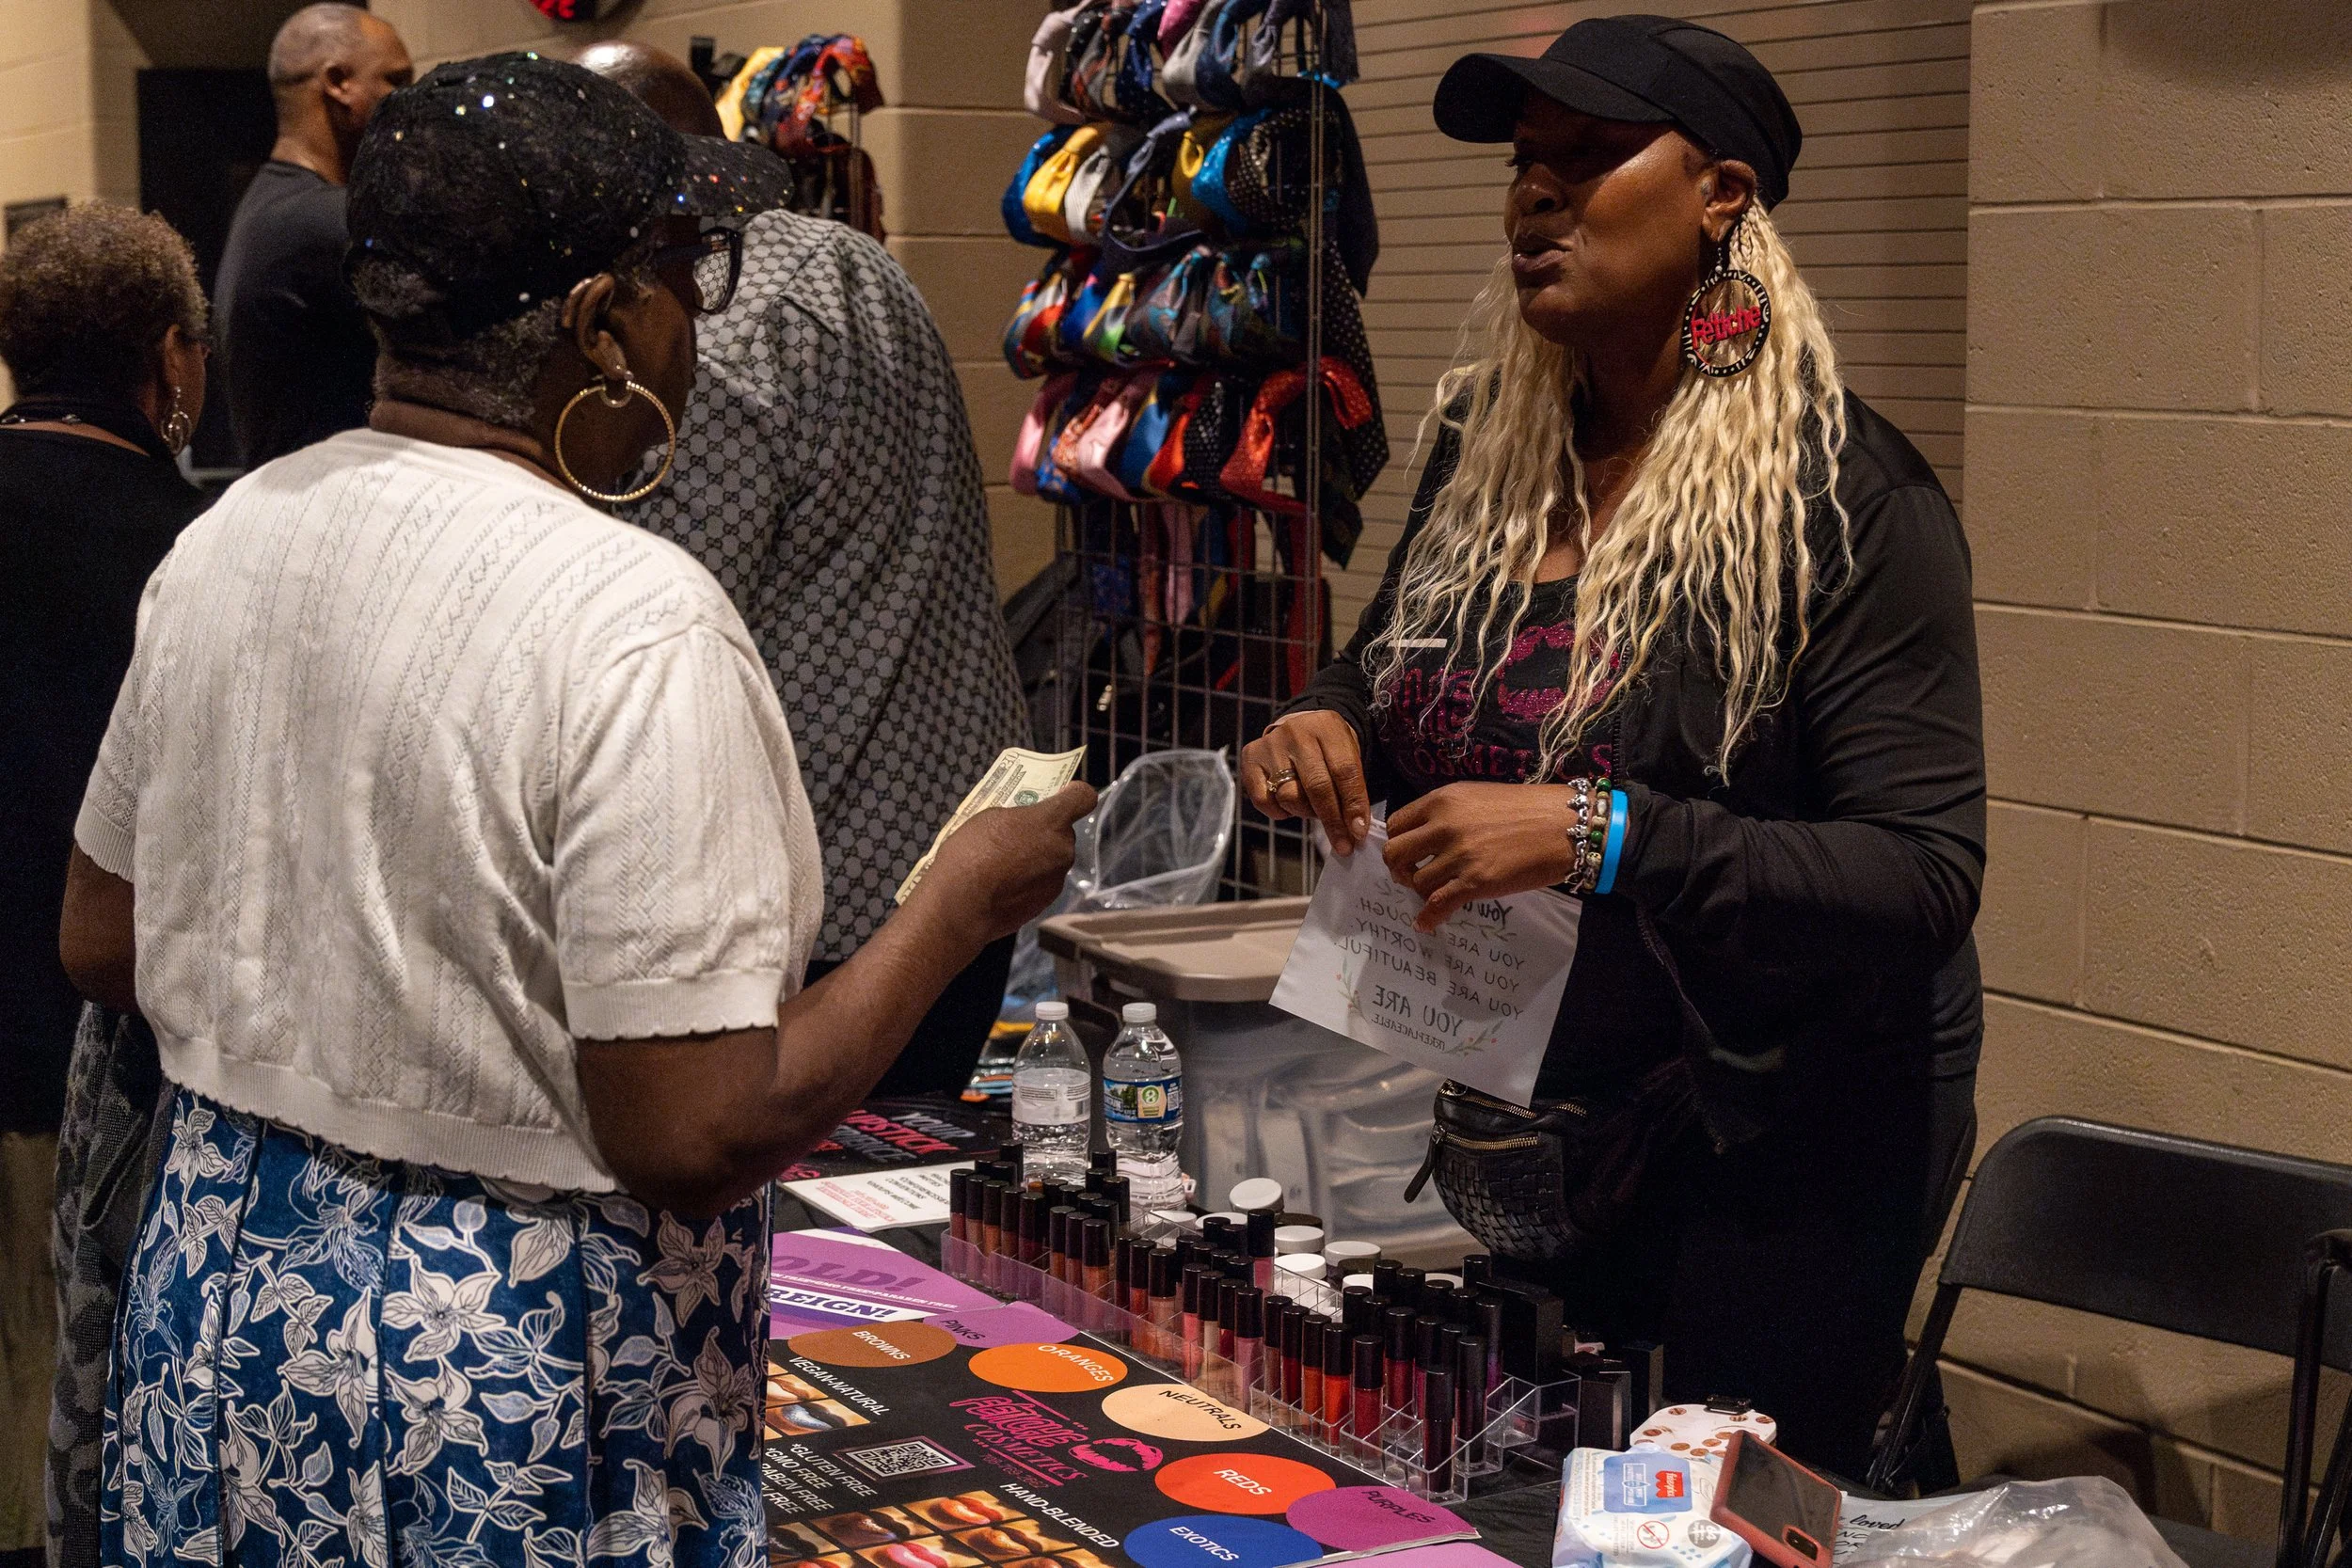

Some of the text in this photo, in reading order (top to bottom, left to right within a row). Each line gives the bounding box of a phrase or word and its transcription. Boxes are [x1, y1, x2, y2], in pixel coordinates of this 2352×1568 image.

[1395, 743, 1613, 779] COSMETCS
[771, 1255, 926, 1291] OLD!
[851, 1330, 912, 1360] BROWNS
[941, 1320, 986, 1340] PINKS
[1038, 1345, 1114, 1383] ORANGES
[788, 1356, 890, 1416] VEGAN-NATURAL
[1158, 1389, 1242, 1431] NEUTRALS
[964, 1424, 1089, 1480] COSMETICS
[791, 1467, 834, 1489] FREE
[835, 1475, 878, 1497] FREE
[1214, 1468, 1273, 1496] REDS
[763, 1492, 805, 1514] FREE
[792, 1490, 834, 1512] FREE
[999, 1482, 1120, 1548] HAND-BLENDED
[1361, 1491, 1437, 1524] PURPLES
[1168, 1526, 1240, 1561] EXOTICS
